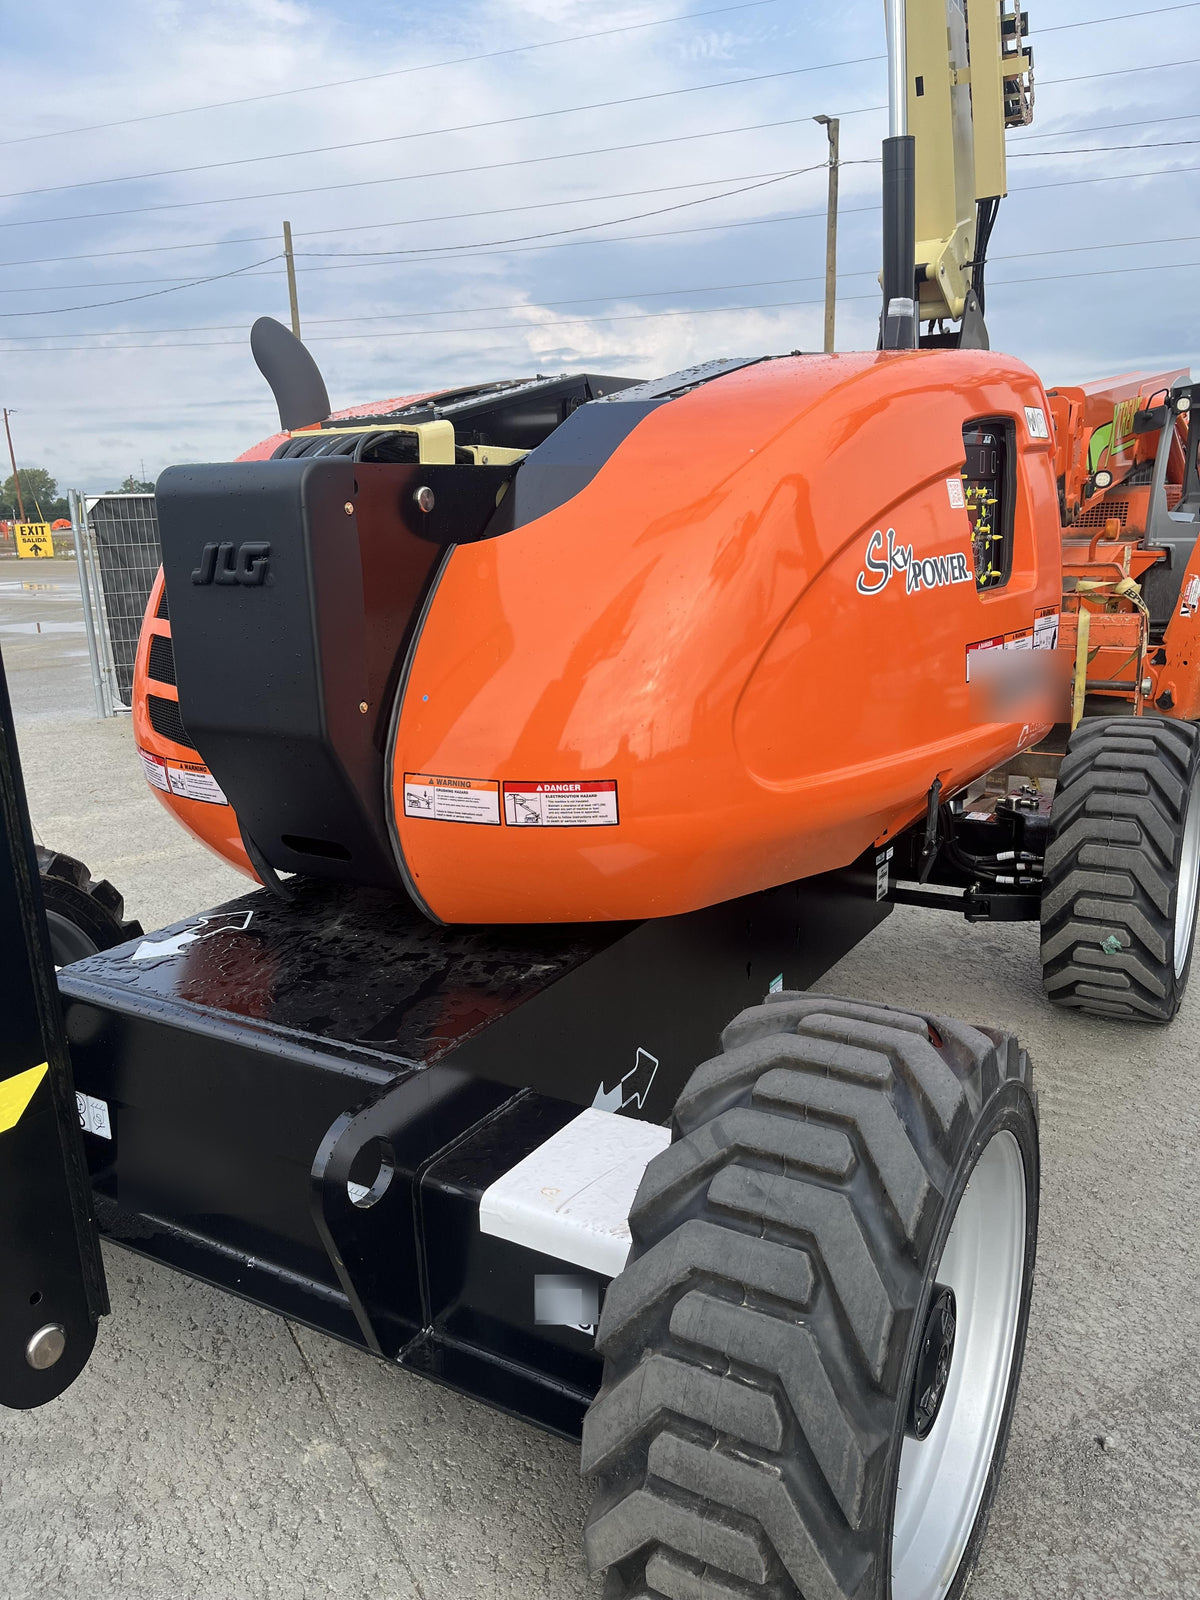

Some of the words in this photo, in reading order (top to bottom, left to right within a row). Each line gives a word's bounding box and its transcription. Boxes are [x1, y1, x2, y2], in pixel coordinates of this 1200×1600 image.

[20, 525, 46, 536] EXIT
[191, 541, 271, 586] JLG
[184, 763, 207, 772] WARNING
[436, 778, 471, 788] WARNING
